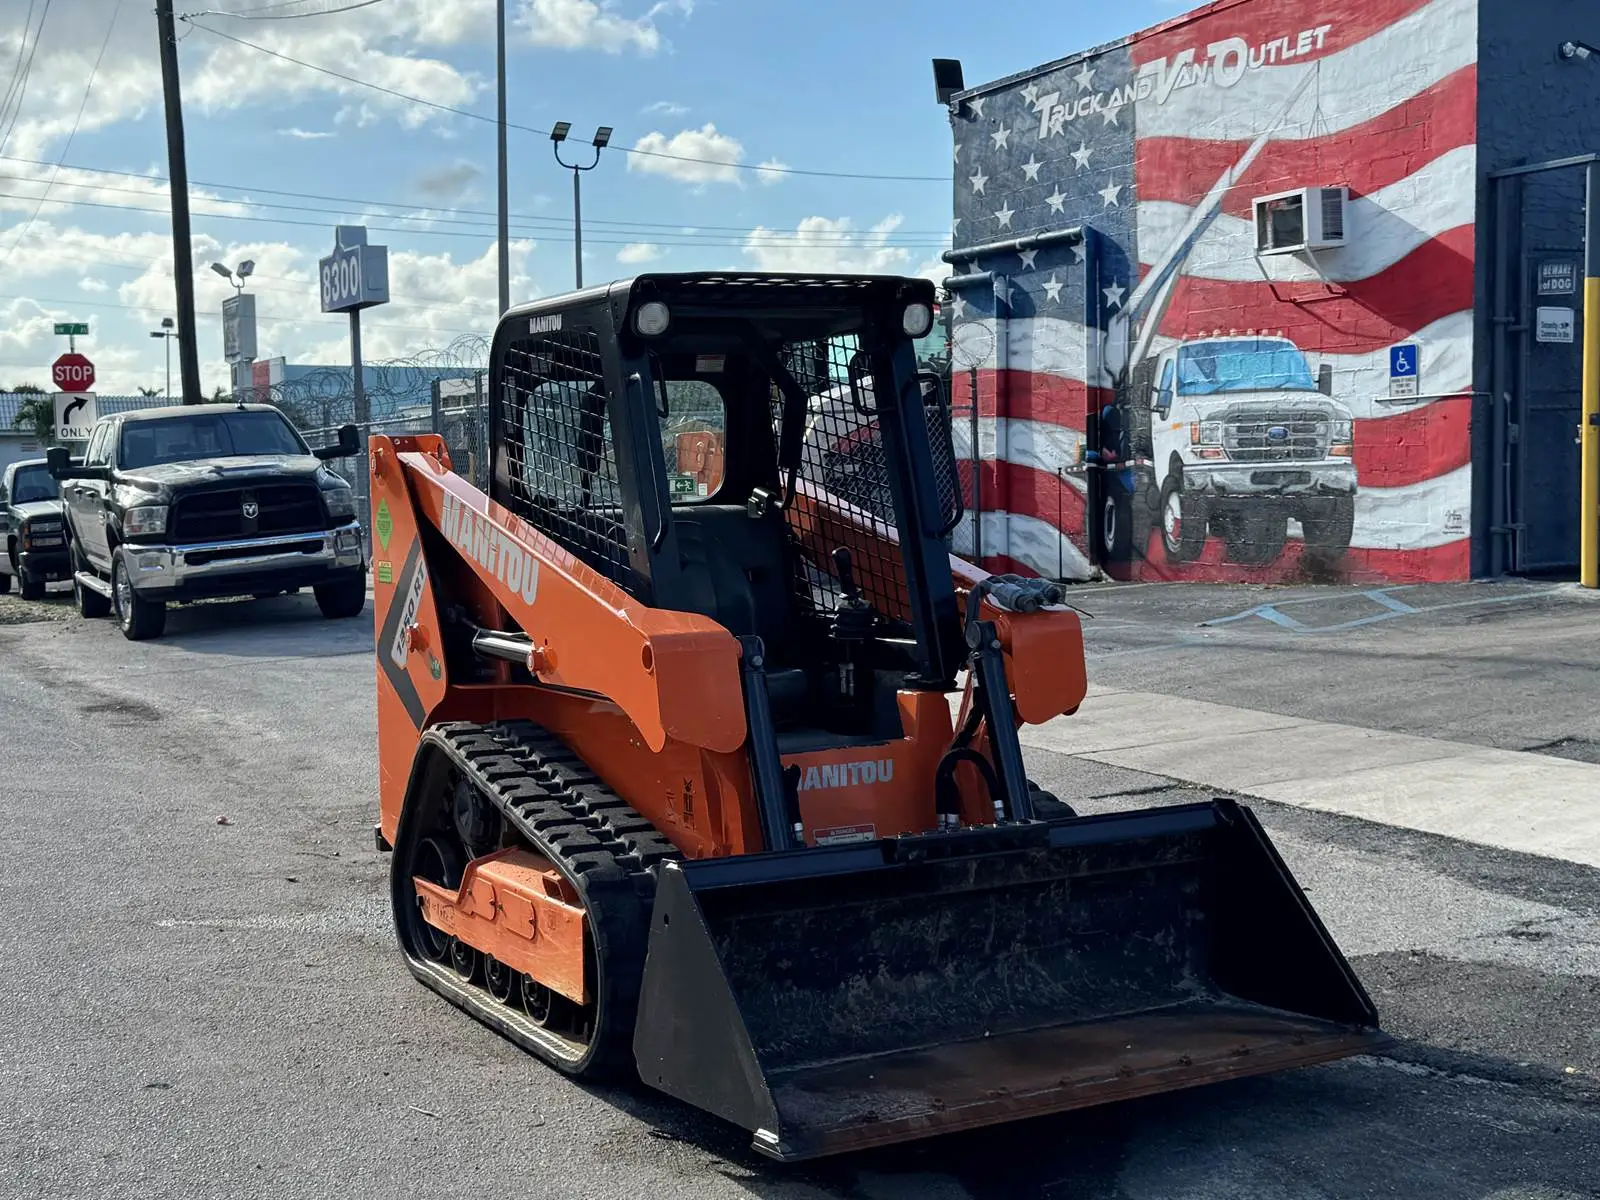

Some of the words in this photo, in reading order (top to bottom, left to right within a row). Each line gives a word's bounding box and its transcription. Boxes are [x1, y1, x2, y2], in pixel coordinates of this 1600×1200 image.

[1207, 24, 1331, 88] OUTLET
[323, 256, 359, 302] 8300
[1551, 279, 1572, 289] DOG
[529, 313, 562, 334] MANITOU
[55, 365, 93, 381] STOP
[61, 427, 93, 438] ONLY
[441, 488, 540, 606] MANITOU
